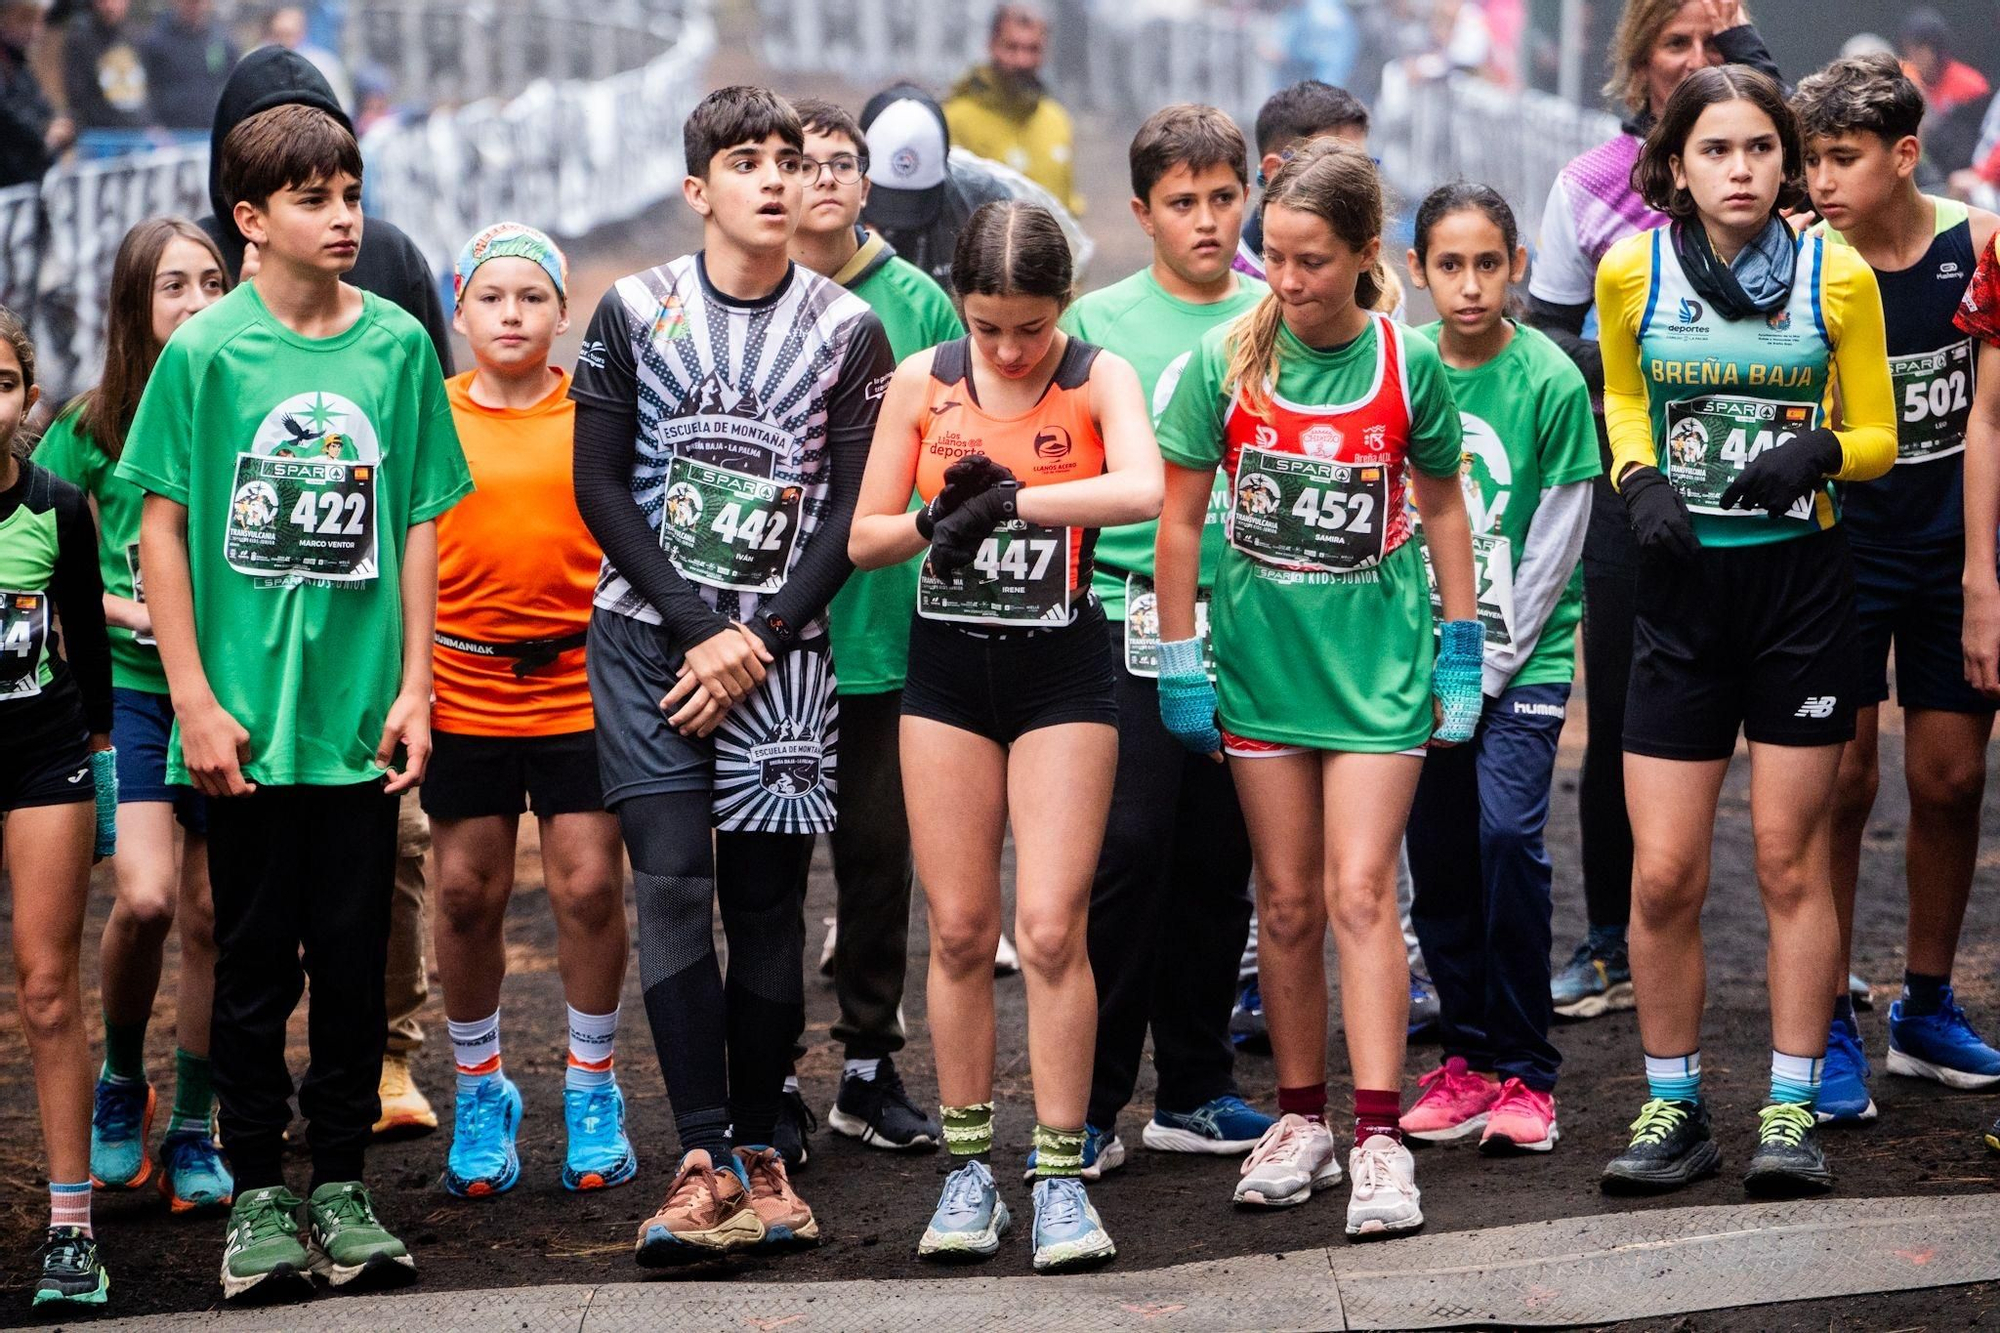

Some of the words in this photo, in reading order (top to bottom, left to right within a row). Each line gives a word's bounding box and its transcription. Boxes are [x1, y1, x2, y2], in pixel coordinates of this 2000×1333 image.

[1668, 325, 1710, 334] deportes
[1651, 356, 1739, 386] BREÑA
[1749, 363, 1812, 388] BAJA
[1904, 370, 1968, 422] 502
[1703, 401, 1755, 416] SPAR
[663, 421, 711, 439] ESCUELA
[714, 421, 729, 433] DE
[730, 423, 786, 450] MONTAÑA
[938, 436, 967, 447] Llanos
[946, 431, 960, 439] Los
[738, 446, 761, 458] PALMA
[1720, 428, 1797, 470] 44
[274, 465, 324, 478] SPAR
[1033, 464, 1056, 472] LLANOS
[1276, 460, 1331, 476] SPAR
[702, 470, 757, 493] SPAR
[290, 491, 366, 535] 422
[1292, 487, 1374, 534] 452
[711, 502, 788, 551] 442
[230, 528, 276, 541] TRANSVULCANIA
[1315, 534, 1345, 545] SAMIRA
[299, 540, 327, 548] MARCO
[328, 541, 355, 549] VENTOR
[735, 553, 755, 562] IVÁN
[974, 538, 1058, 580] 447
[1260, 571, 1291, 580] SPAR
[1308, 571, 1380, 585] KIDS-JUNIOR
[0, 619, 32, 658] 4
[754, 746, 787, 758] ESCUELA
[789, 745, 798, 753] DE
